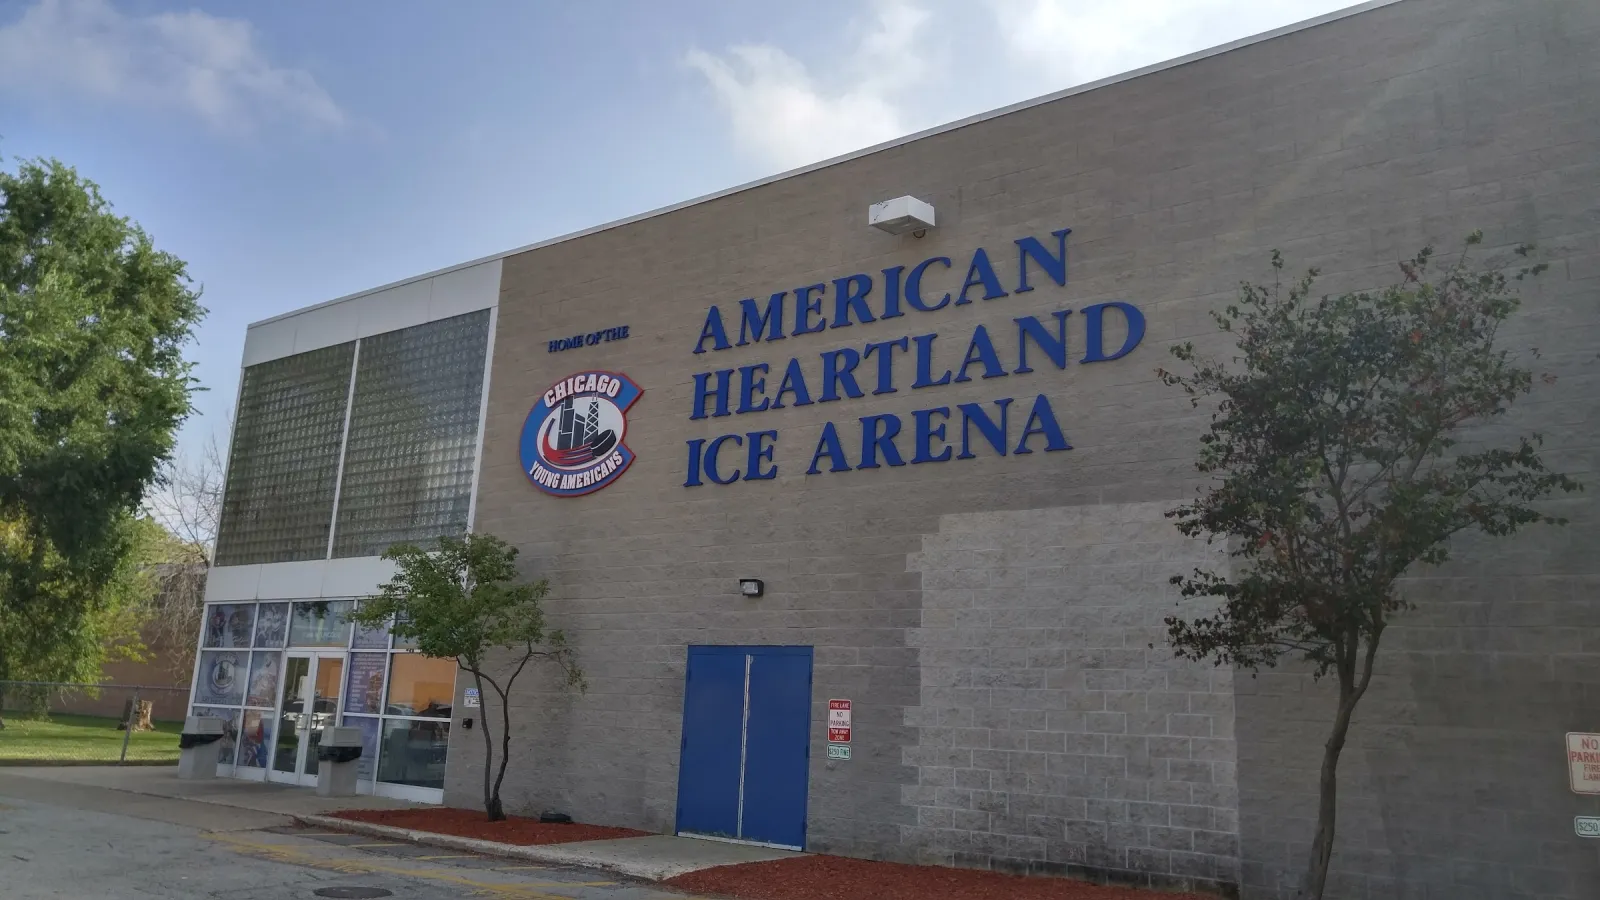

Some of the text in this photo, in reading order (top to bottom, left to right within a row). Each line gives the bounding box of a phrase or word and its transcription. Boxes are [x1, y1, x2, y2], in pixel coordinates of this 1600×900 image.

[692, 228, 1072, 354] AMERICAN
[548, 325, 630, 353] HOME OF THE
[690, 301, 1147, 420] HEARTLAND
[543, 373, 621, 408] CHICAGO
[684, 394, 1073, 488] ICE ARENA
[529, 450, 624, 490] YOUNG AMERICANS
[840, 748, 849, 757] FINE
[1571, 750, 1600, 763] PARKI
[1581, 738, 1599, 750] NO
[1583, 772, 1600, 781] LAN
[1578, 821, 1599, 832] $250
